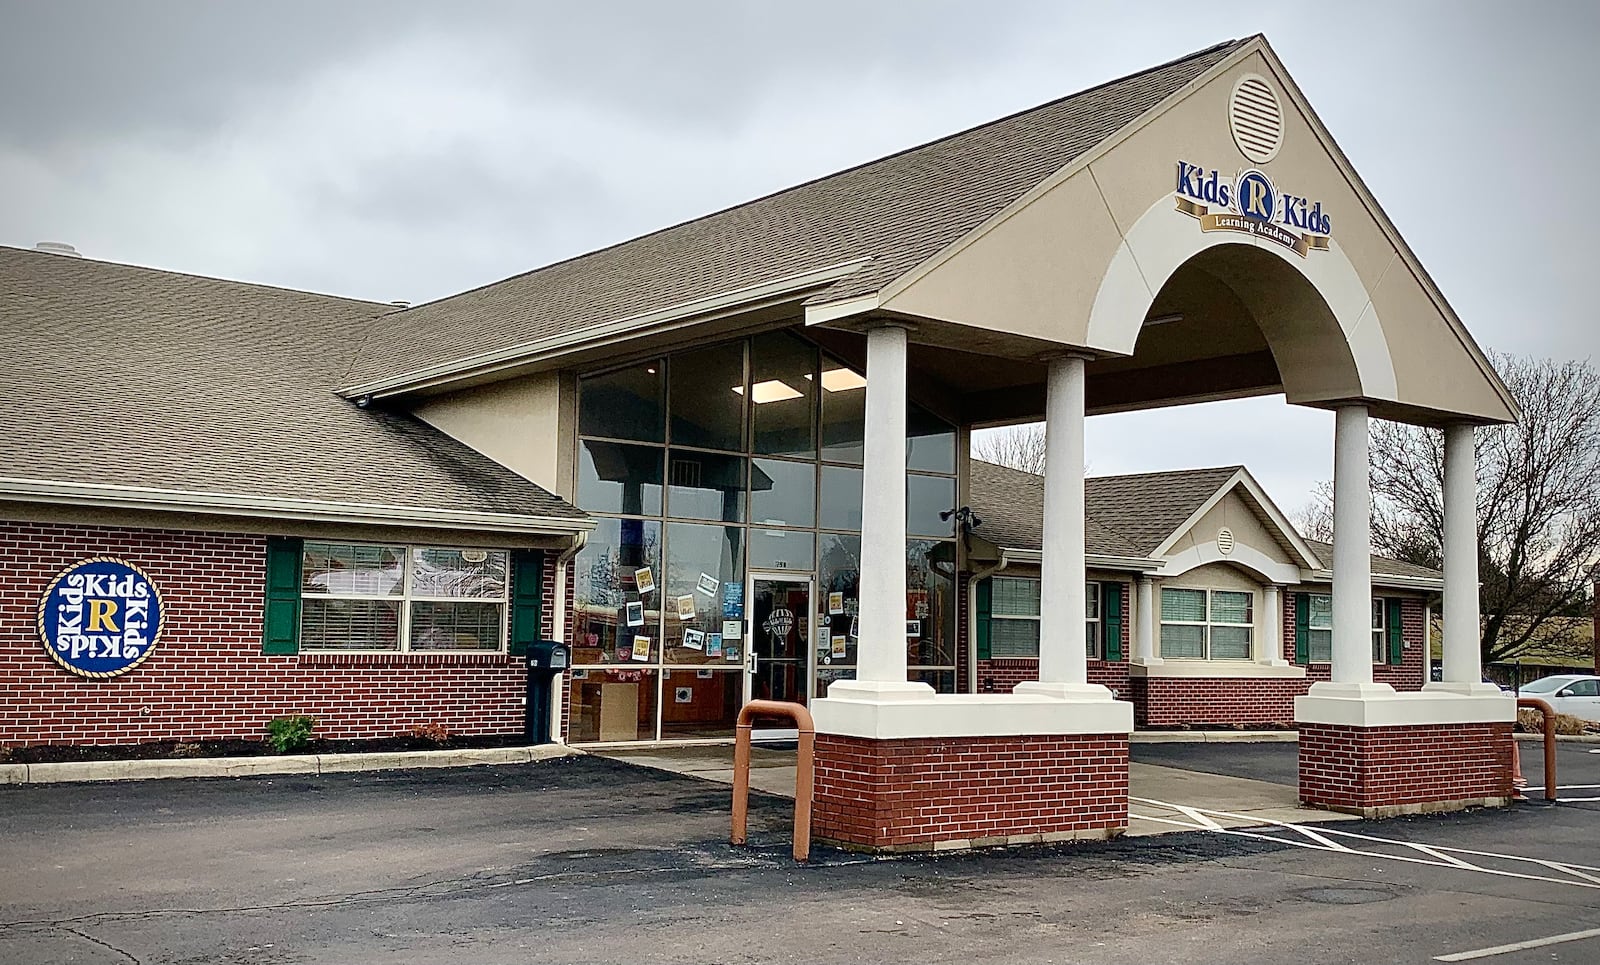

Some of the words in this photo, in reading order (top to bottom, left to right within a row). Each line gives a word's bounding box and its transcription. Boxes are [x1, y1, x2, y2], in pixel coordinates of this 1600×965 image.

[1177, 161, 1229, 207] Kids
[1247, 178, 1268, 218] R
[1283, 194, 1331, 234] Kids
[1215, 216, 1255, 233] Learning
[1257, 222, 1297, 248] Academy
[83, 574, 148, 598] Kids
[57, 574, 85, 636] Kids
[85, 599, 121, 632] R
[123, 598, 149, 659] Kids
[57, 635, 122, 659] Kids
